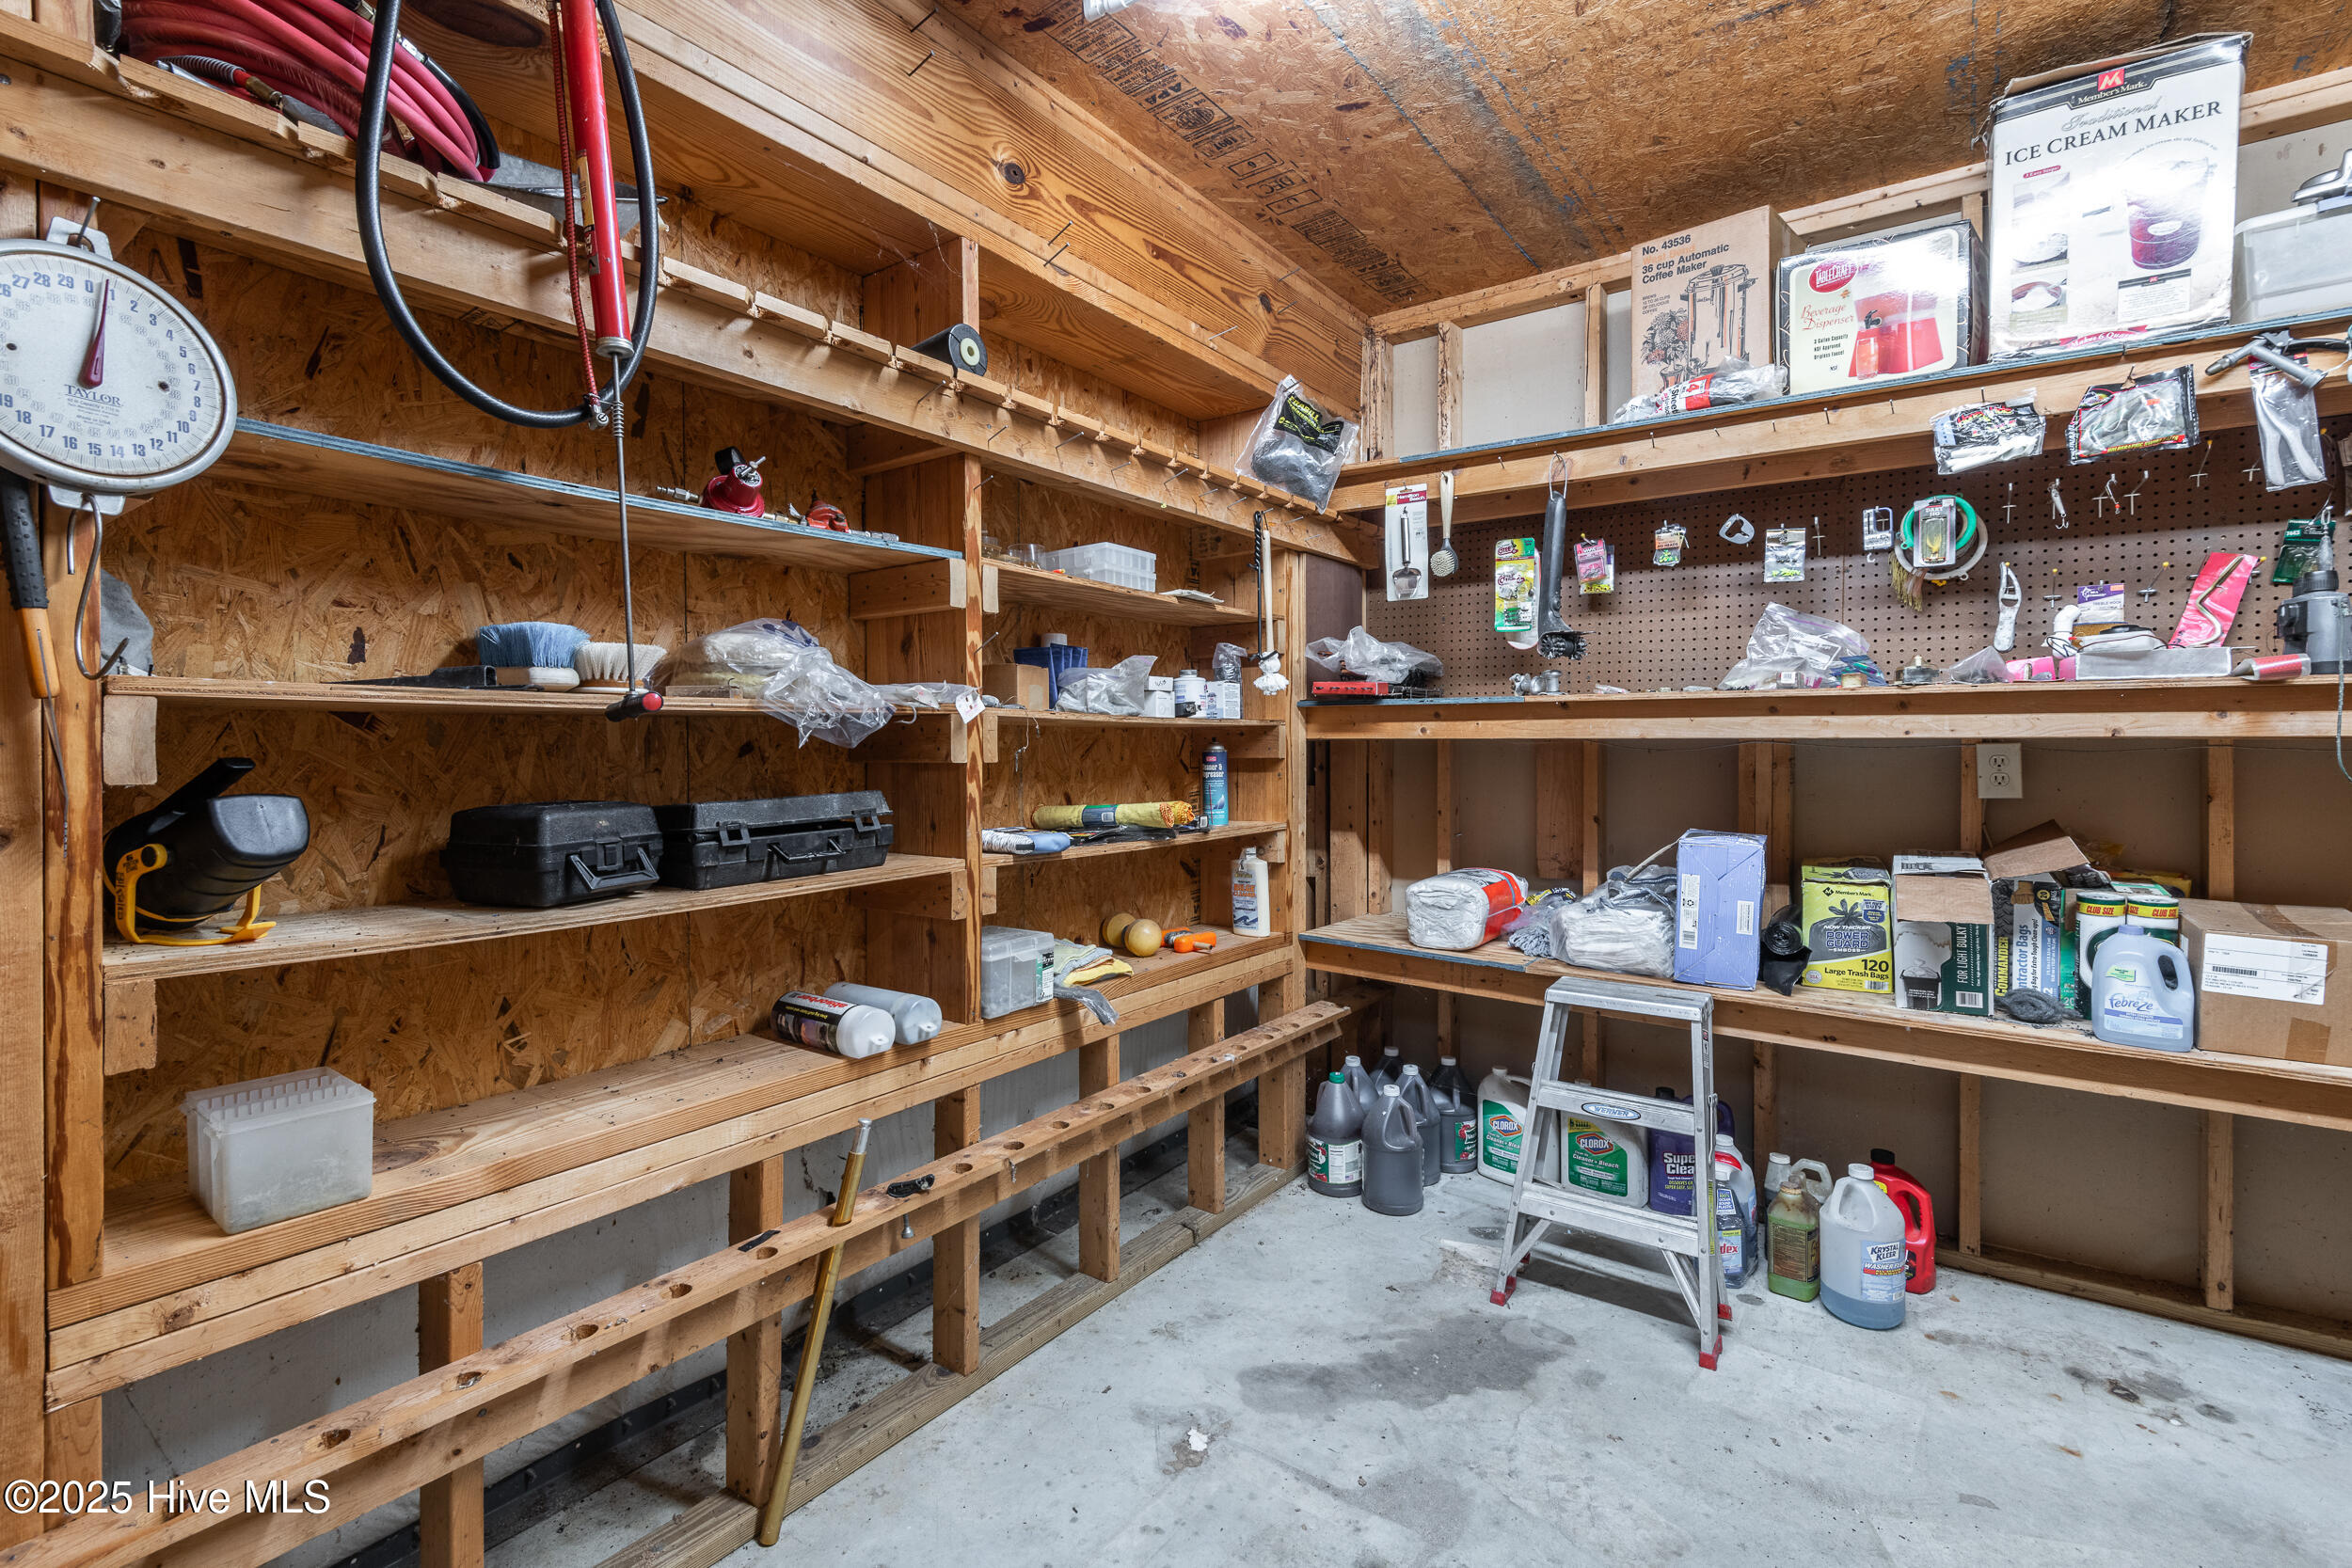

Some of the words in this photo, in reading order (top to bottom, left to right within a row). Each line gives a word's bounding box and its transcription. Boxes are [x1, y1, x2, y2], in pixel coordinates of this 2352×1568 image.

[1144, 81, 1183, 104] APA
[2077, 87, 2120, 104] Member's
[2061, 95, 2164, 132] Traditional
[2005, 143, 2042, 166] ICE
[2046, 120, 2129, 154] CREAM
[2134, 100, 2223, 134] MAKER
[1261, 171, 1297, 196] DEC
[1642, 245, 1659, 256] No.
[1661, 234, 1692, 250] 43536
[1642, 264, 1654, 275] 36
[1656, 260, 1675, 271] cup
[1677, 244, 1730, 264] Automatic
[33, 272, 51, 287] 28
[1642, 271, 1674, 284] Coffee
[1677, 261, 1707, 276] Maker
[12, 274, 30, 289] 27
[57, 273, 74, 289] 29
[85, 279, 93, 293] 0
[0, 283, 11, 297] 6
[109, 289, 115, 301] 1
[130, 299, 138, 313] 2
[1801, 304, 1847, 319] Beverage
[150, 313, 157, 326] 3
[1802, 313, 1854, 331] Dispenser
[166, 329, 174, 341] 4
[179, 345, 187, 358] 5
[1822, 342, 1841, 351] Approved
[188, 362, 196, 375] 6
[193, 379, 201, 391] 7
[64, 384, 121, 406] TAYLOR
[194, 395, 201, 408] 8
[15, 409, 32, 424] 18
[189, 409, 197, 422] 9
[39, 424, 56, 438] 17
[177, 420, 190, 434] 10
[62, 436, 78, 450] 16
[167, 430, 178, 443] 11
[87, 442, 103, 456] 15
[110, 444, 125, 458] 14
[132, 443, 146, 457] 13
[150, 437, 165, 451] 12
[2086, 905, 2102, 914] CLUB
[2103, 906, 2115, 915] SIZE
[2152, 909, 2168, 917] CLUB
[1826, 931, 1869, 941] POWER
[1956, 926, 1967, 945] BULKY
[2016, 924, 2031, 947] Bags
[1826, 941, 1869, 949] GUARD
[1957, 945, 1967, 969] LIGHT
[1861, 958, 1890, 973] 120
[1994, 936, 2010, 997] COMMANDER
[2016, 948, 2028, 989] ntractor
[1824, 967, 1847, 977] Large
[1848, 969, 1869, 978] Trash
[1870, 972, 1890, 981] Bags
[1957, 970, 1967, 984] FOR
[1594, 1105, 1629, 1117] WERNER
[1492, 1120, 1518, 1131] CLOROX
[1486, 1134, 1505, 1145] Cleaner
[1580, 1138, 1610, 1148] CLOROX
[1572, 1153, 1595, 1164] Cleaner
[1598, 1160, 1619, 1168] Bleach
[1663, 1152, 1695, 1165] Supe
[1666, 1164, 1694, 1175] Clea
[1720, 1243, 1739, 1254] dex
[1870, 1243, 1899, 1255] KRYSTAL
[1876, 1251, 1897, 1261] KLEER
[1864, 1261, 1894, 1270] WASHER
